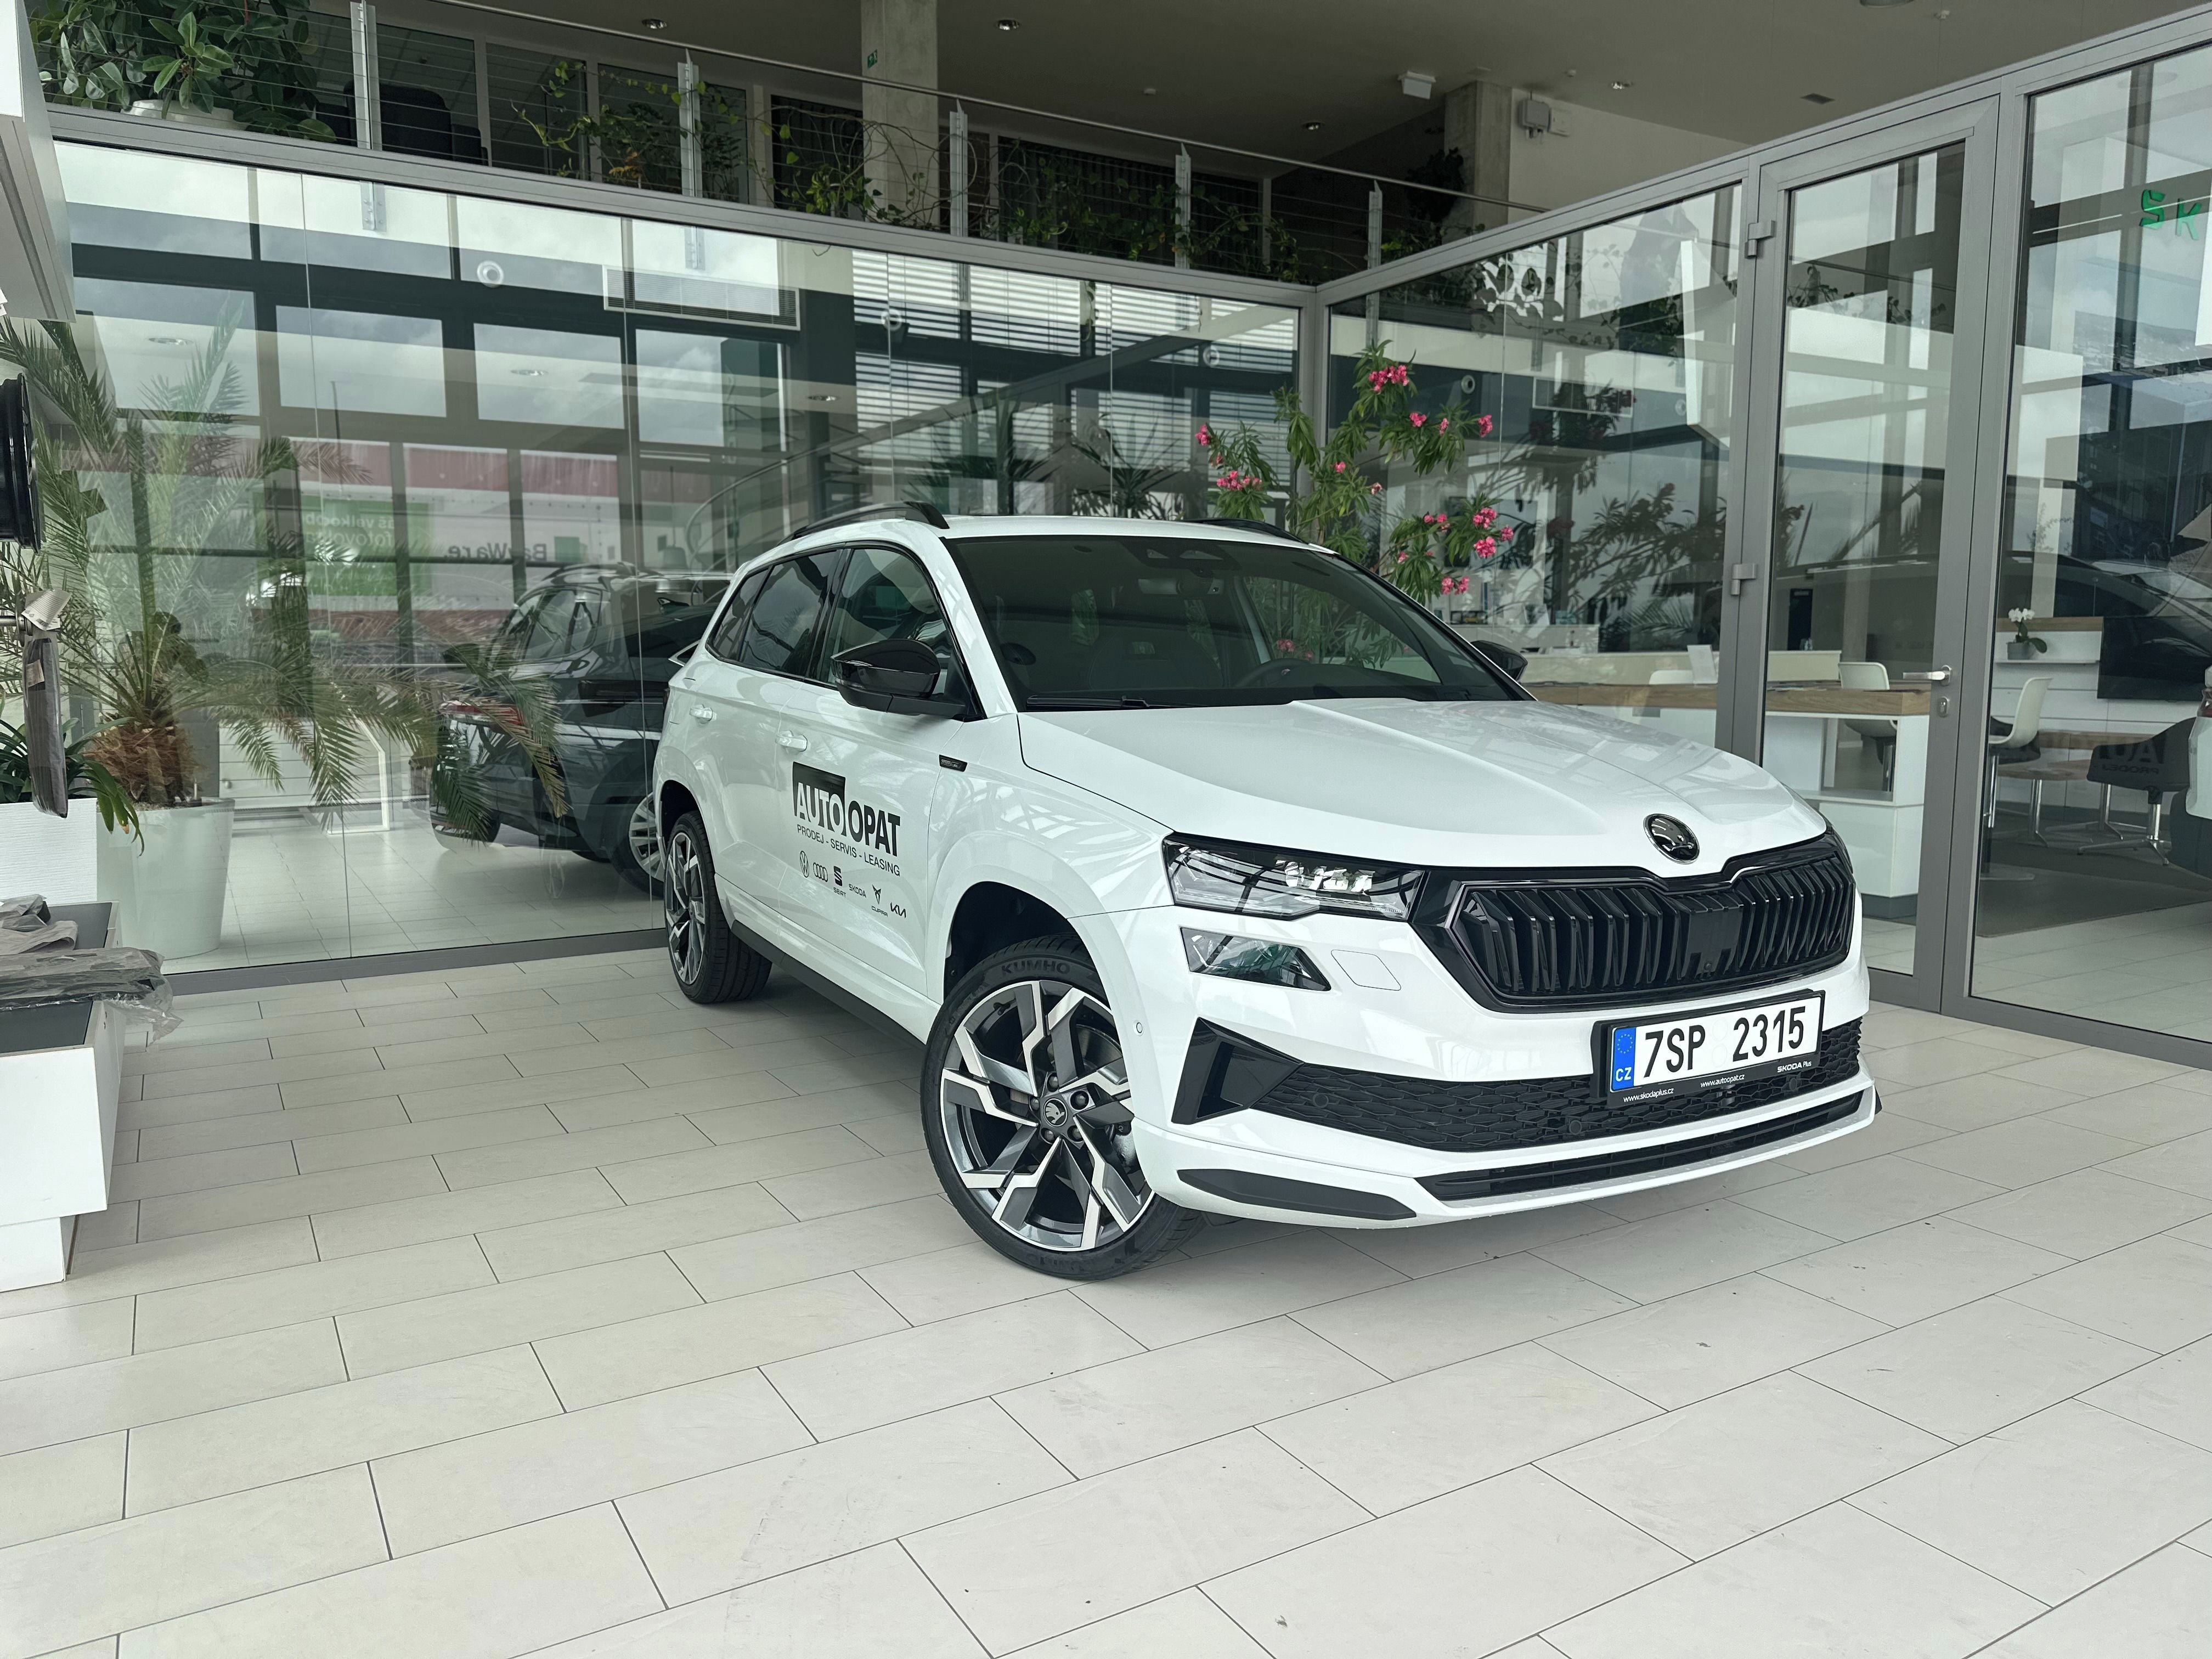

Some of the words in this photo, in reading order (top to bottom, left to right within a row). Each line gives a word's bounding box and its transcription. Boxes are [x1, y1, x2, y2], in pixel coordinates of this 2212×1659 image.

[797, 823, 824, 844] PRODEJ
[831, 838, 857, 858] SERVIS
[864, 852, 900, 877] LEASING
[833, 887, 847, 898] SEAT
[871, 905, 888, 917] CUPRA
[1001, 960, 1070, 977] KUMHO
[1644, 1024, 1706, 1078] 7SP
[1733, 1006, 1805, 1062] 2315
[1616, 1066, 1632, 1082] CZ
[1700, 1074, 1745, 1088] www.autoopat.cz
[1623, 1088, 1674, 1102] www.skodaplus.cz
